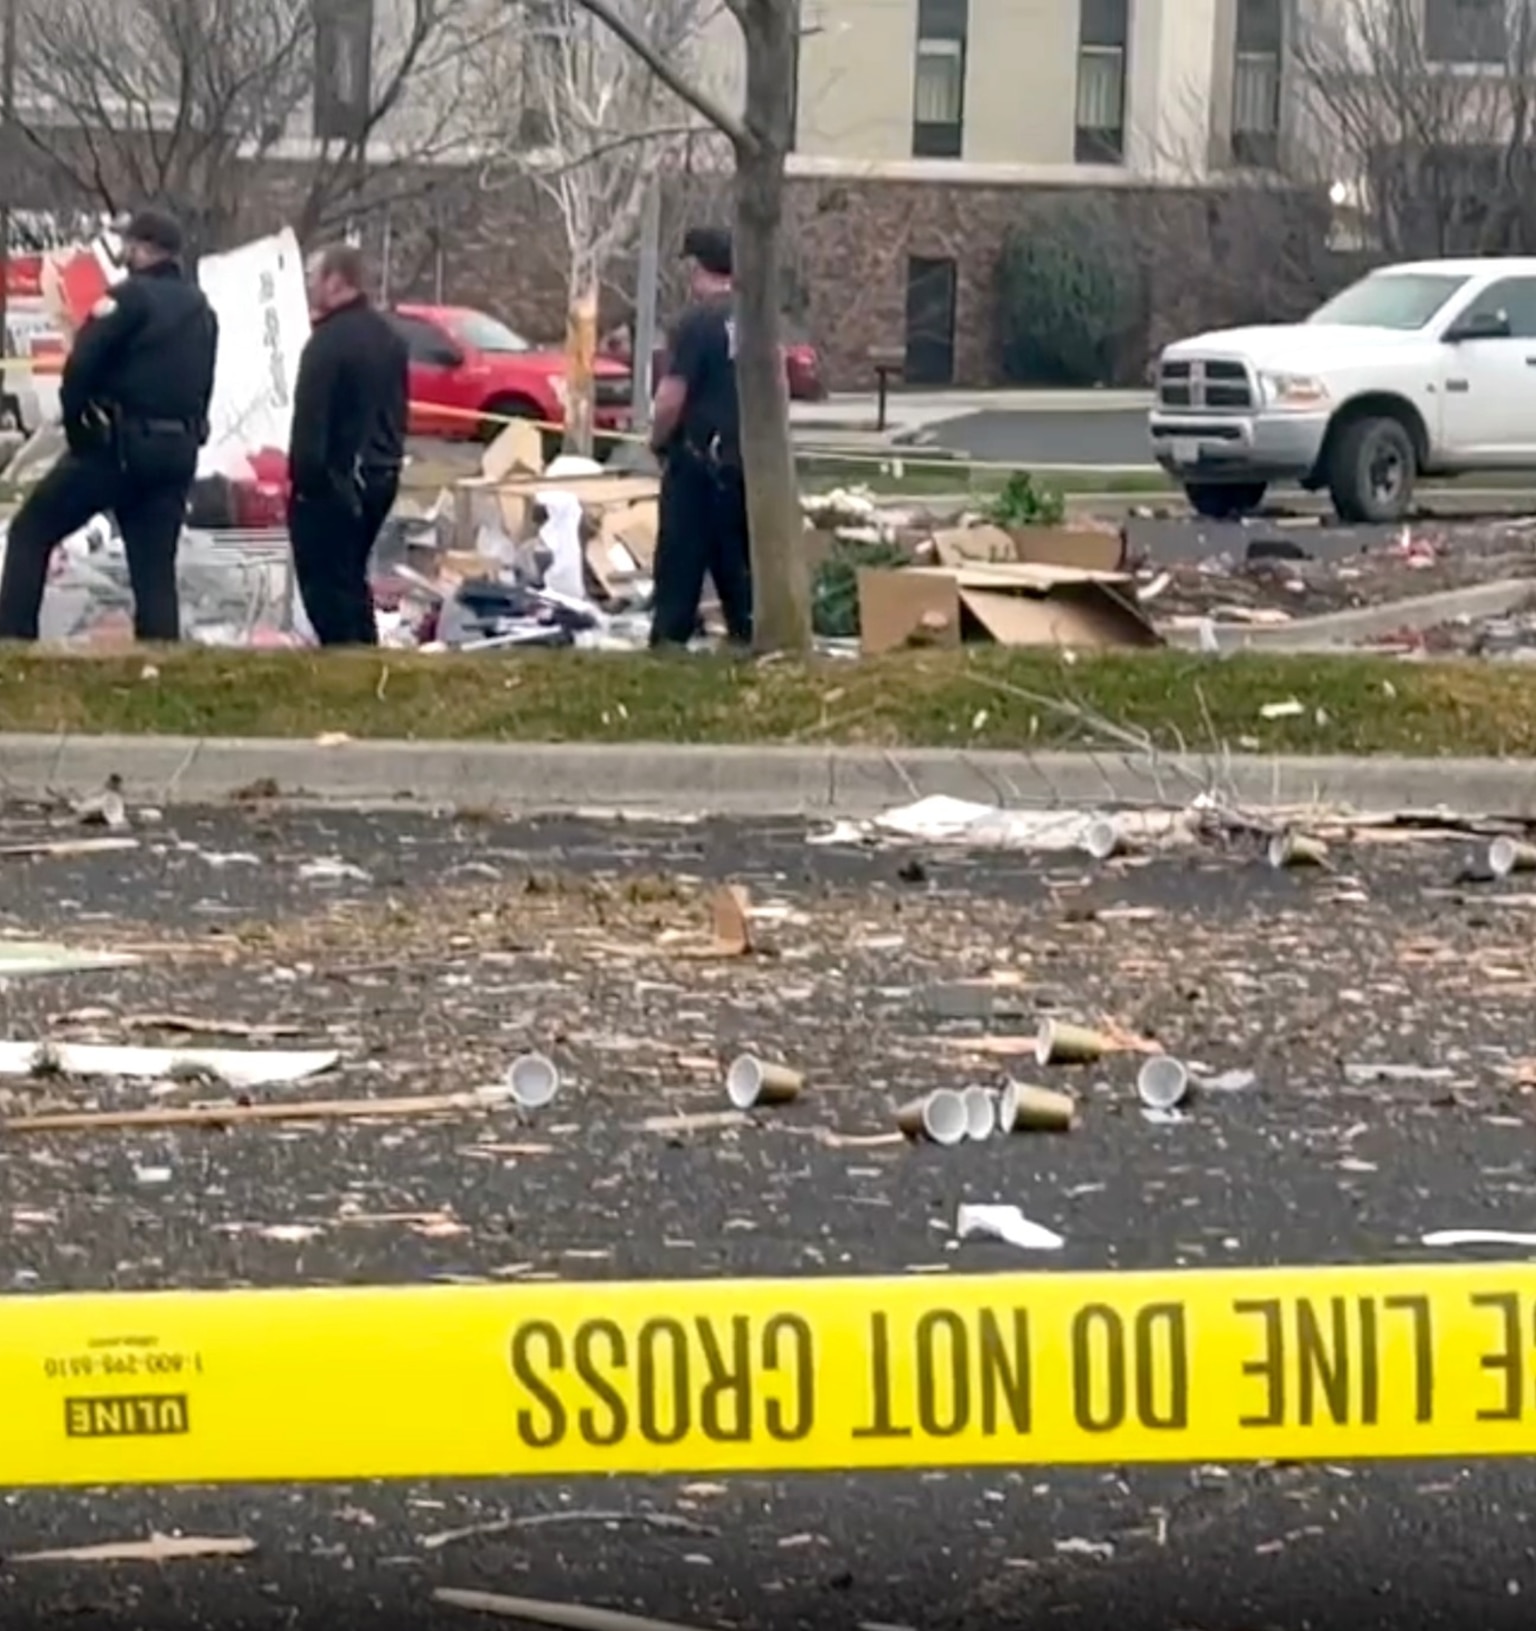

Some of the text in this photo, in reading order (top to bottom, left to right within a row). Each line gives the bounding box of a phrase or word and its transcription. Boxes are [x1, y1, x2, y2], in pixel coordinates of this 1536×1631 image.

[67, 1396, 186, 1436] ULINE
[511, 1312, 815, 1449] CROSS
[851, 1307, 1032, 1439] NOT
[1071, 1302, 1188, 1434] DO
[1233, 1295, 1434, 1429] LINE
